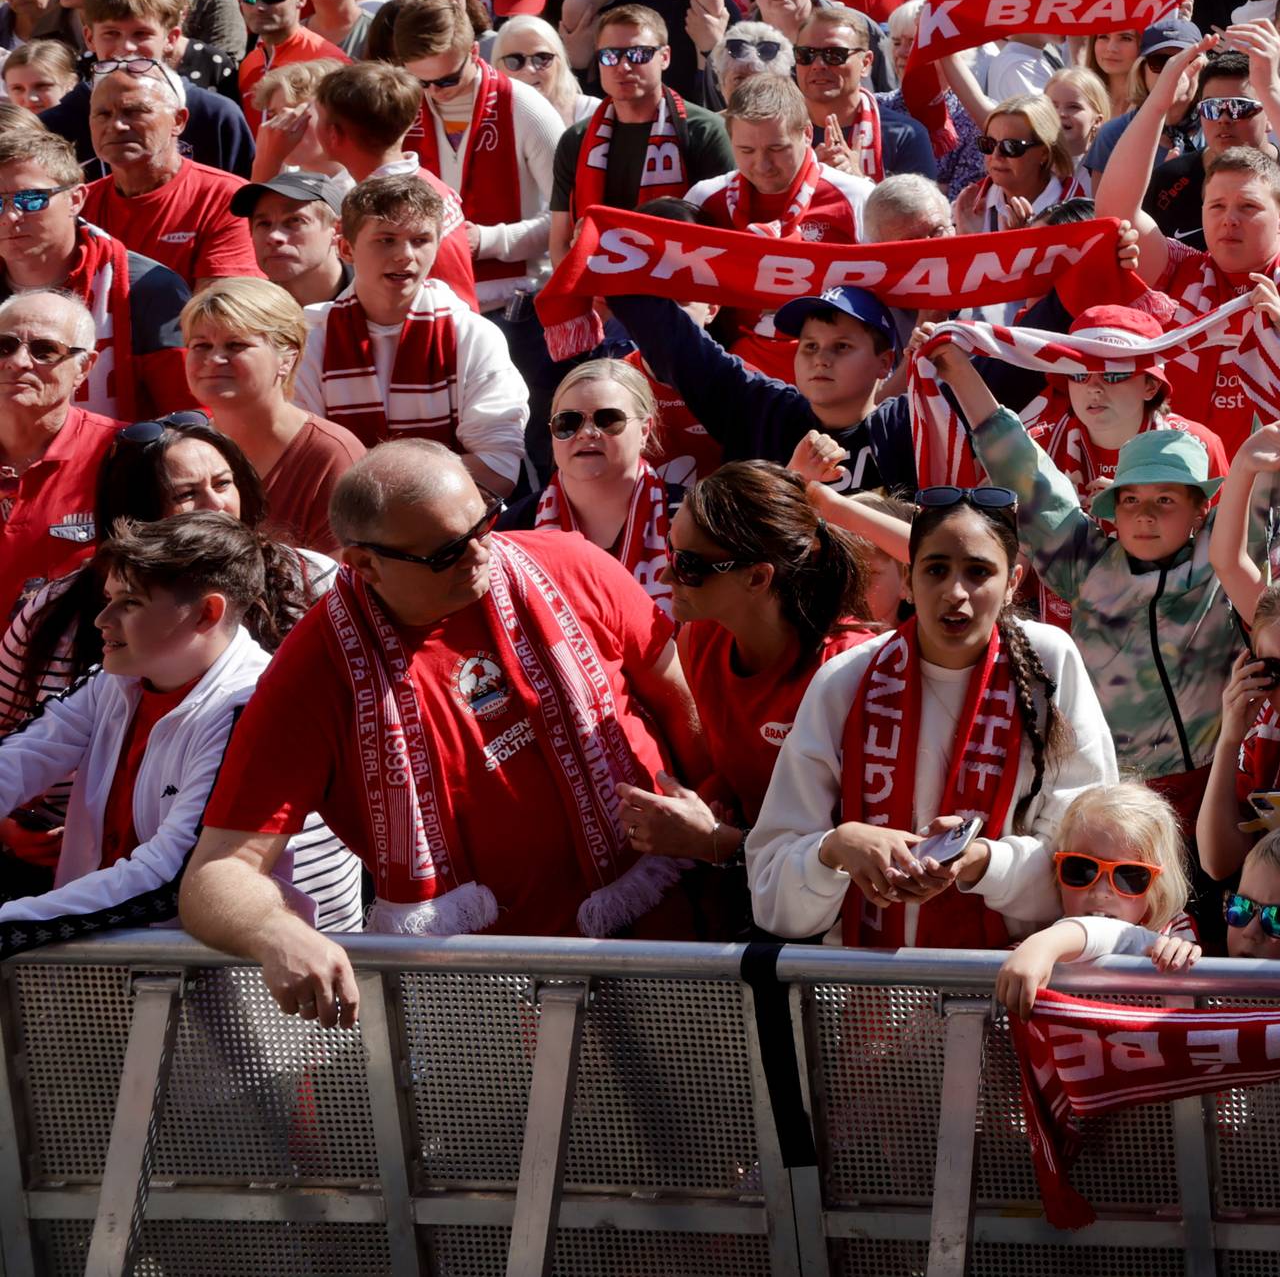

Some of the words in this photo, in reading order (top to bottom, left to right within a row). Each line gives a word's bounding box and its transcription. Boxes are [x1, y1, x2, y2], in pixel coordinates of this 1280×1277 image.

[588, 227, 727, 287] SK
[514, 634, 559, 720] ULLEVAAL
[557, 602, 609, 693] ULLEVAAL
[384, 726, 408, 786] 1999
[483, 716, 531, 760] BERGEN
[484, 729, 536, 772] STOLTHE
[357, 688, 380, 781] ULLEVAAL
[369, 790, 388, 866] STADION
[562, 752, 608, 861] CUPFINALEN
[418, 790, 448, 864] STADION
